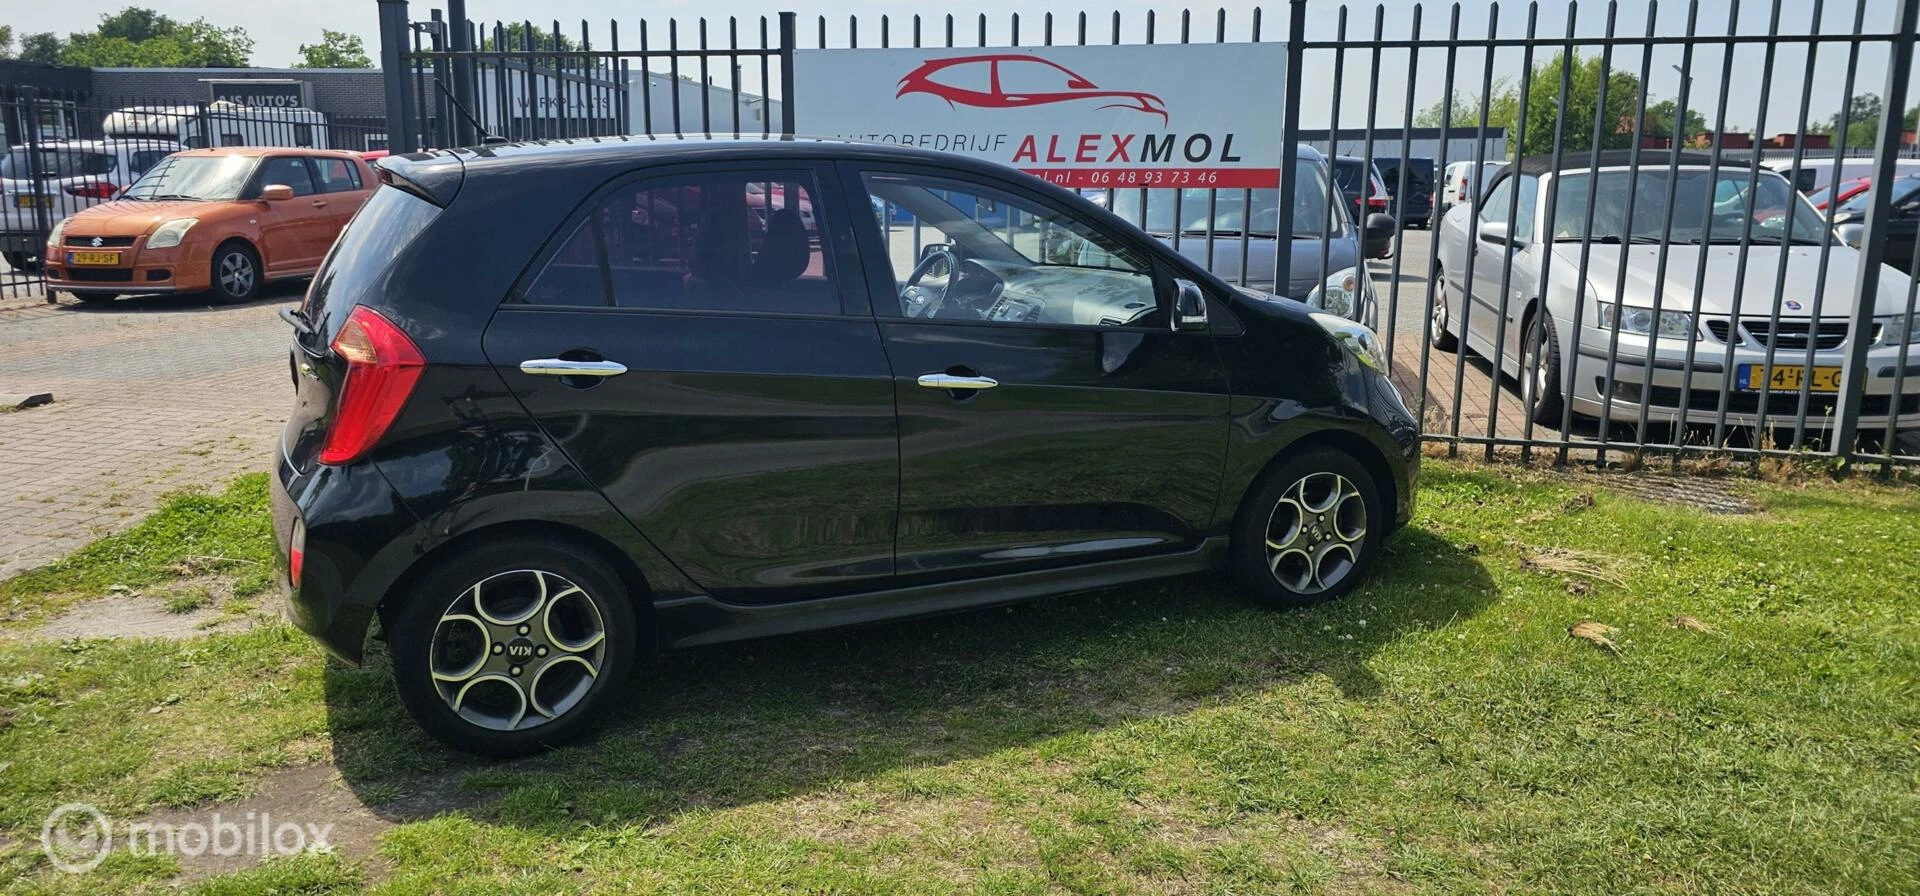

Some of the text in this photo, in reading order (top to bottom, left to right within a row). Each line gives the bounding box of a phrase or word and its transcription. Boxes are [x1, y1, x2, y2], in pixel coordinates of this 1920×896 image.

[247, 95, 298, 107] AUTO'S
[1091, 171, 1109, 183] 06
[1117, 171, 1136, 183] 48
[1144, 171, 1162, 183] 93
[1171, 171, 1189, 183] 73
[1198, 171, 1217, 183] 46
[509, 646, 532, 656] KIA
